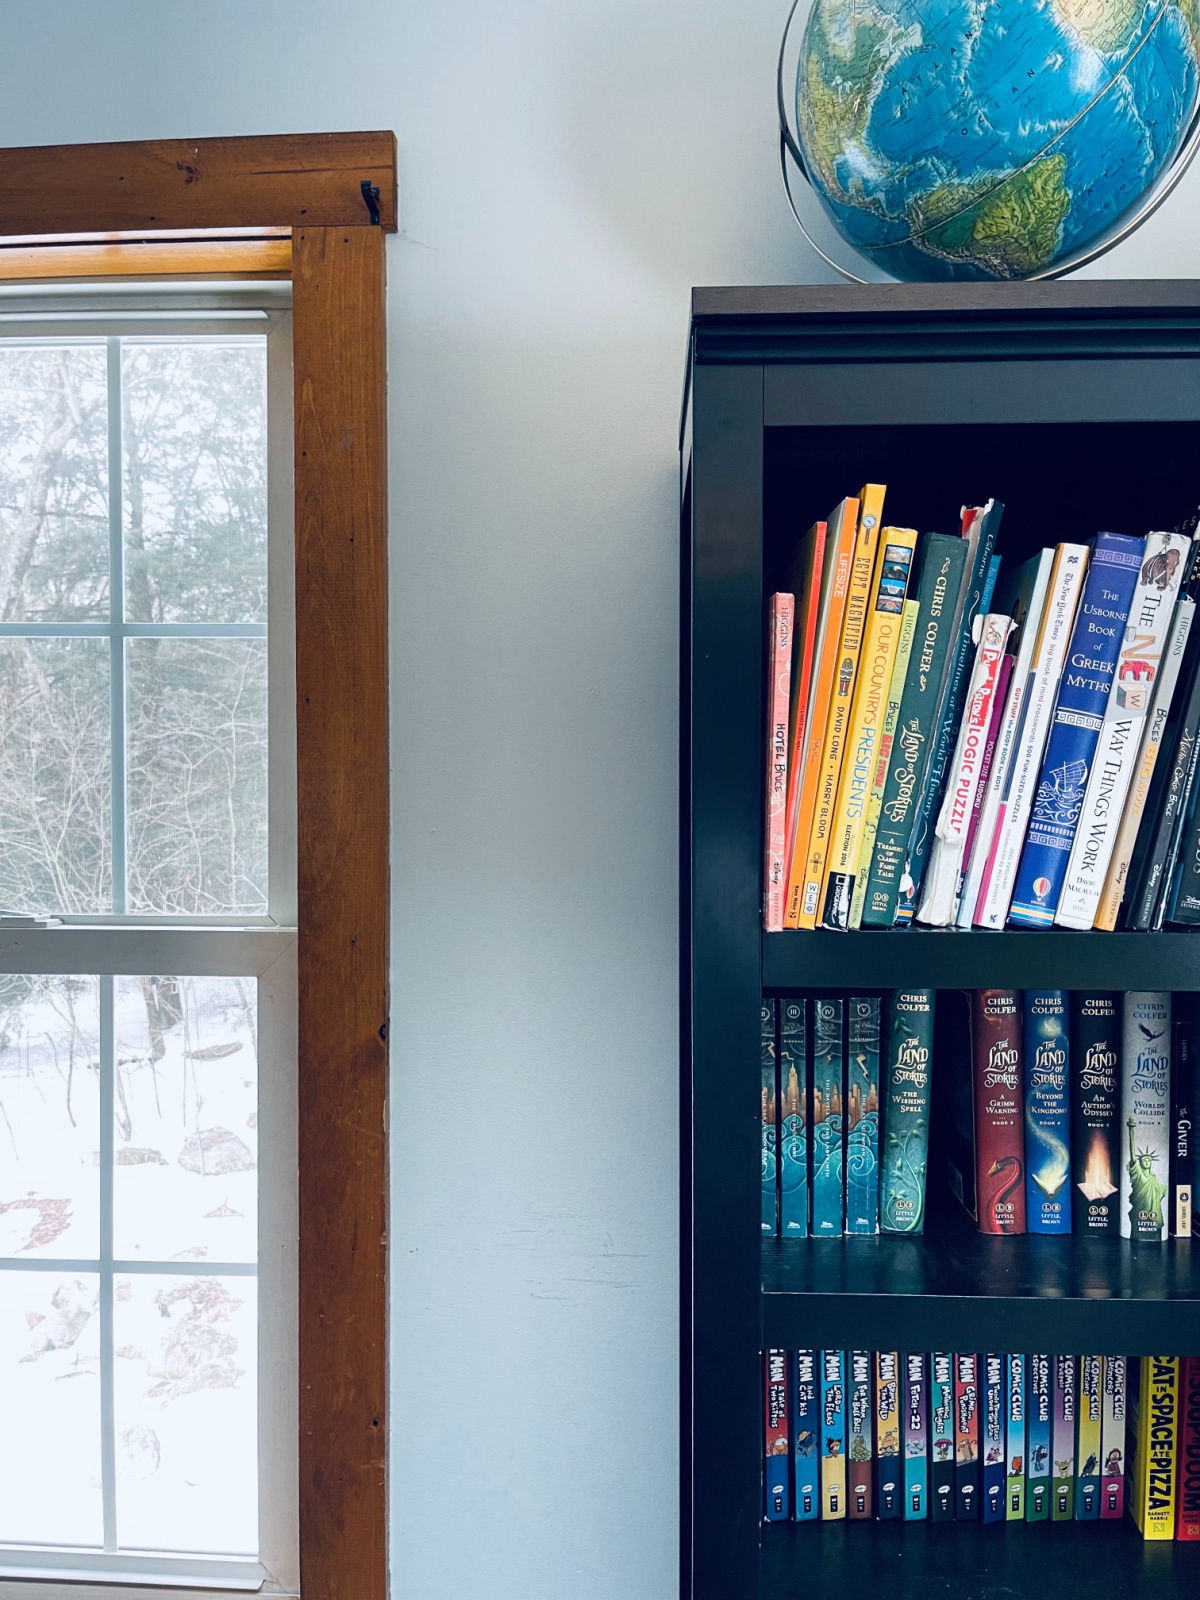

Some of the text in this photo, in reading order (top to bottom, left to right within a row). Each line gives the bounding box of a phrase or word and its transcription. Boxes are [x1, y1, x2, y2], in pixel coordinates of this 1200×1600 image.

[979, 533, 994, 578] Usborne
[834, 553, 849, 597] LIFESIZE
[844, 557, 870, 649] EGYPT MAGNIFIED
[1101, 590, 1120, 601] THE
[920, 577, 949, 672] CHRIS COLFER
[1083, 604, 1127, 622] USBORNE
[1139, 595, 1162, 628] THE
[877, 625, 892, 653] OUR
[901, 615, 914, 653] HIGGINS
[1088, 622, 1116, 637] BOOK
[1173, 617, 1190, 656] HIGGINS
[1093, 643, 1103, 651] of
[952, 630, 973, 692] Timelines
[1071, 654, 1115, 674] GREEK
[863, 655, 887, 725] COUNTRY'S
[1010, 571, 1074, 823] The New York Times big book of mini crosswords 500 FUN-SIZED PUZZLES
[1066, 675, 1110, 694] MYTHS
[776, 724, 785, 759] HOTEL
[993, 687, 1021, 791] GUY STUFF BODY BOOK BOYS
[1109, 719, 1132, 755] WAY
[1177, 728, 1195, 767] Mother
[875, 734, 893, 787] BIG STORM
[961, 728, 980, 773] LOGIC
[817, 707, 845, 838] DAVID LONG HARRY BLOOM
[847, 727, 876, 818] PRESIDENTS
[884, 725, 925, 823] LAND STORIES
[974, 741, 994, 808] POCKET SIZE SUDOKU
[1133, 743, 1158, 814] BIG MOVE
[1183, 775, 1193, 796] WORLD
[1094, 759, 1121, 817] THINGS
[843, 825, 852, 851] ELECTION
[1081, 823, 1107, 872] WORK
[877, 855, 899, 864] CLASSIC
[879, 862, 895, 870] FAIRY
[1000, 847, 1015, 889] JOEL FAGLIANO
[877, 869, 894, 878] TALES
[1076, 876, 1096, 887] DAVID
[990, 882, 1000, 904] SHORTZ
[1107, 892, 1120, 924] HYPERION
[896, 1003, 930, 1012] COLFER
[900, 994, 927, 1003] CHRIS
[984, 1006, 1017, 1014] COLFER
[987, 998, 1014, 1006] CHRIS
[1031, 1006, 1065, 1014] COLFER
[1034, 998, 1062, 1006] CHRIS
[1085, 999, 1113, 1007] CHRIS
[1136, 1003, 1165, 1011] CHRIS
[1081, 1008, 1116, 1016] COLFER
[1133, 1011, 1168, 1020] COLFER
[892, 1043, 929, 1069] LAND
[983, 1046, 1018, 1073] LAND
[1030, 1046, 1066, 1073] LAND
[1079, 1048, 1118, 1075] LAND
[1131, 1052, 1169, 1079] LAND
[892, 1070, 928, 1088] STORIES
[984, 1073, 1019, 1091] STORIES
[1030, 1073, 1066, 1090] STORIES
[1080, 1074, 1118, 1092] STORIES
[1131, 1079, 1169, 1096] STORIES
[892, 1095, 926, 1105] WISHING
[900, 1105, 923, 1113] SPELL
[1036, 1092, 1064, 1100] BEYOND
[1093, 1094, 1105, 1102] AN
[1134, 1100, 1165, 1108] WORLDS
[985, 1106, 1019, 1114] WARNING
[1083, 1108, 1113, 1116] ODYSSEY
[1133, 1107, 1165, 1116] COLLIDE
[1177, 1119, 1192, 1157] GIVER
[770, 1356, 784, 1382] MAN
[799, 1356, 813, 1382] MAN
[826, 1356, 841, 1381] MAN
[853, 1356, 868, 1382] MAN
[880, 1354, 895, 1380] MAN
[908, 1355, 923, 1381] MAN
[935, 1357, 950, 1383] MAN
[959, 1357, 975, 1383] MAN
[987, 1358, 1000, 1384] MAN
[834, 1385, 842, 1404] LORD
[1011, 1395, 1022, 1422] CLUB
[1039, 1395, 1048, 1422] CLUB
[1064, 1395, 1073, 1422] CLUB
[1090, 1395, 1099, 1421] CLUB
[1114, 1395, 1124, 1421] CLUB
[1151, 1393, 1175, 1451] SPACE
[1149, 1458, 1172, 1511] PIZZA
